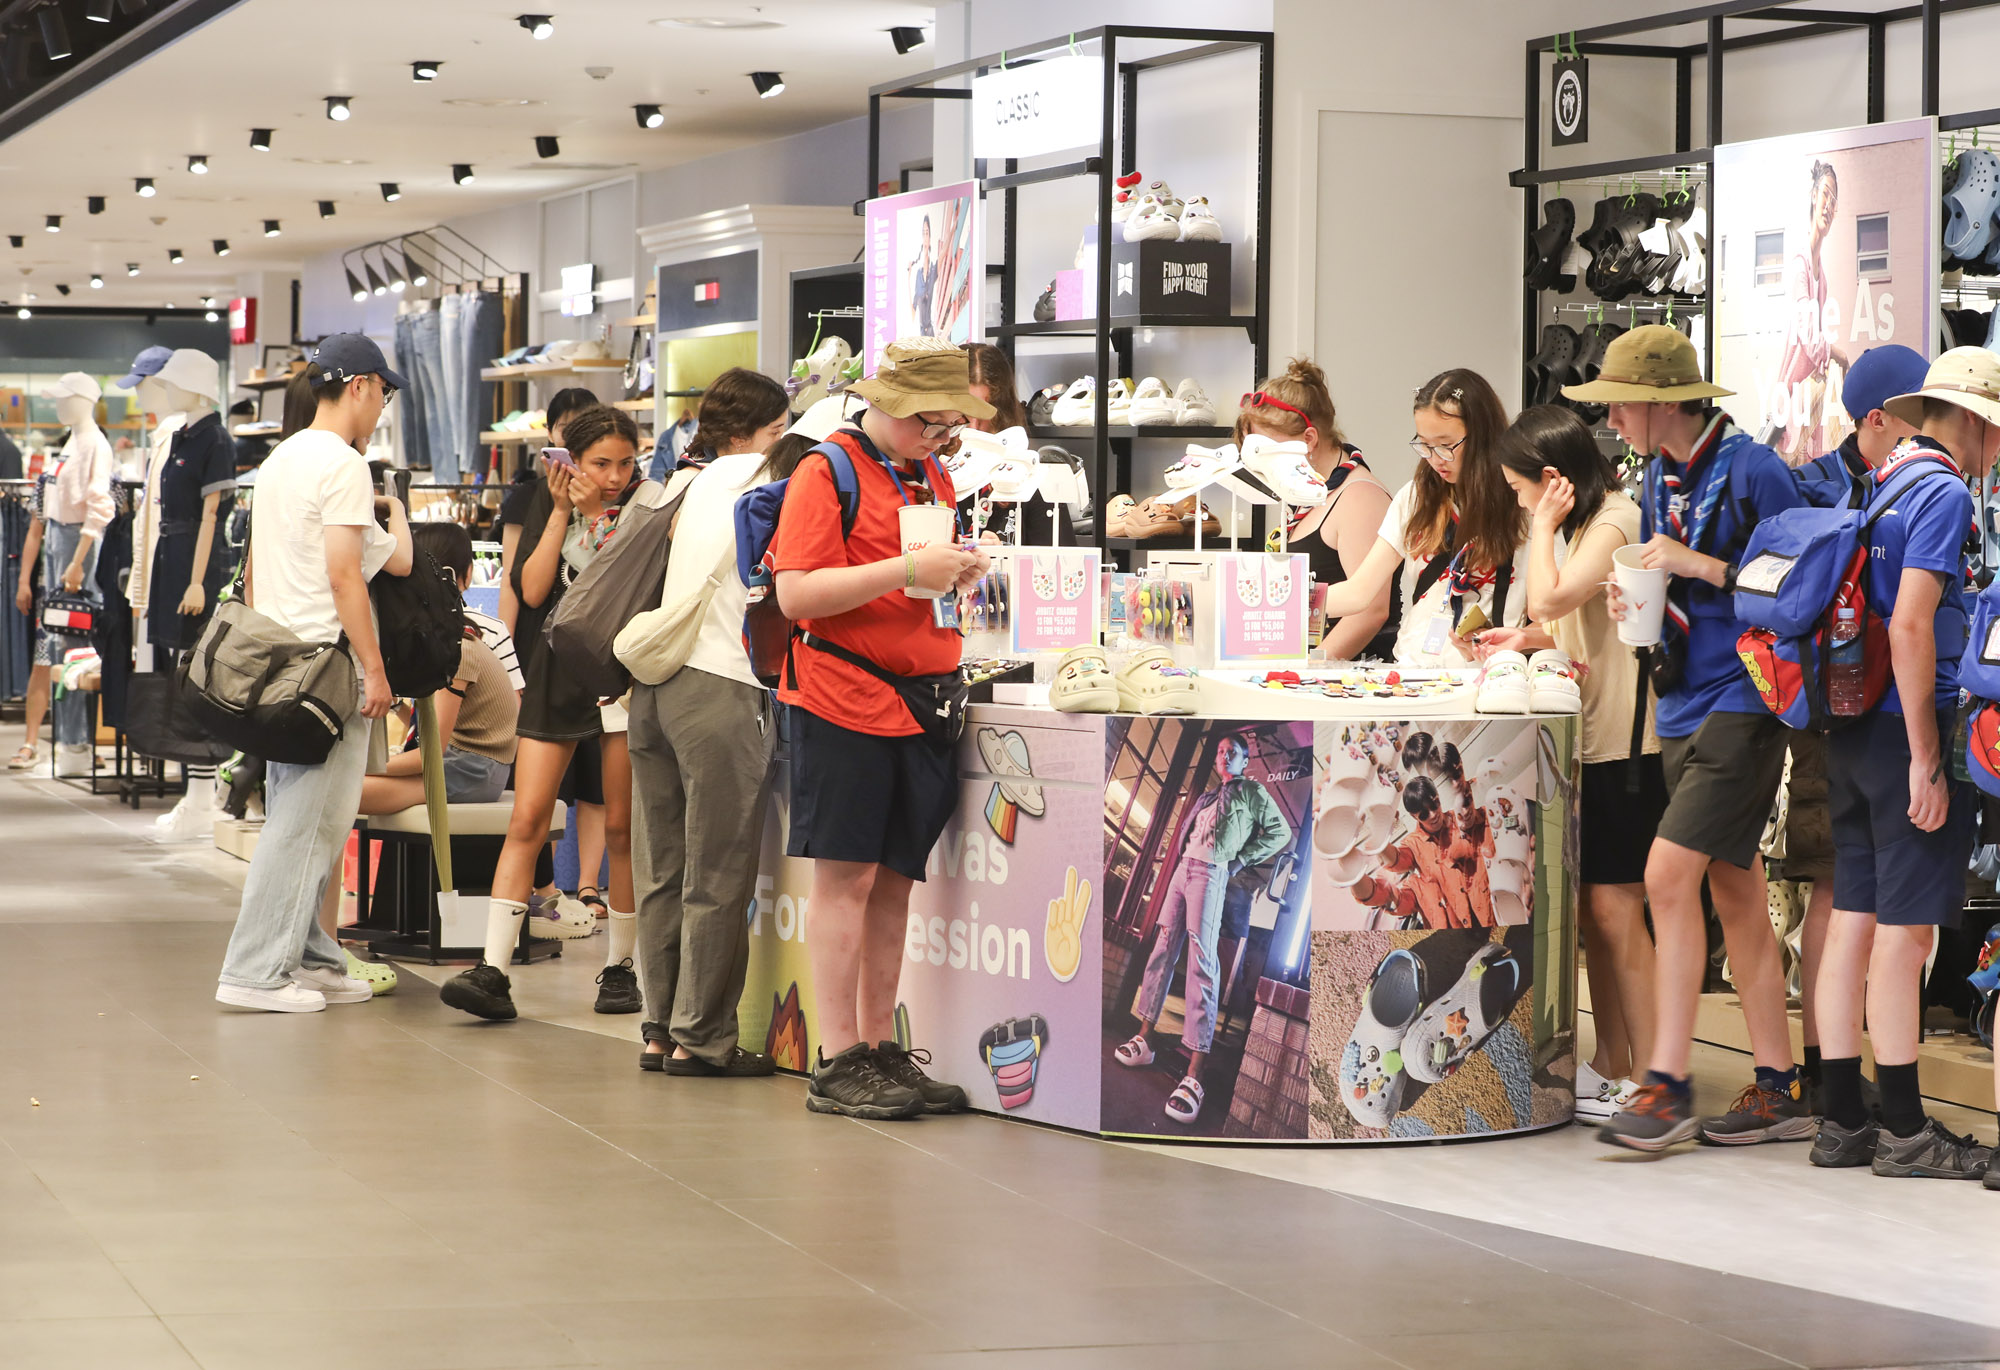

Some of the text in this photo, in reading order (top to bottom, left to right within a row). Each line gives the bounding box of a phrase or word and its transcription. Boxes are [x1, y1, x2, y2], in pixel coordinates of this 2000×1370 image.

[996, 90, 1041, 126] CLASSIC
[873, 216, 890, 309] HEIGHT
[1163, 261, 1208, 280] FIND YOUR
[1163, 276, 1208, 297] HAPPY HEIGHT
[1850, 278, 1895, 342] As
[1751, 366, 1811, 429] You
[907, 541, 928, 552] CGV
[1266, 770, 1299, 783] DAILY
[905, 900, 1031, 980] ession
